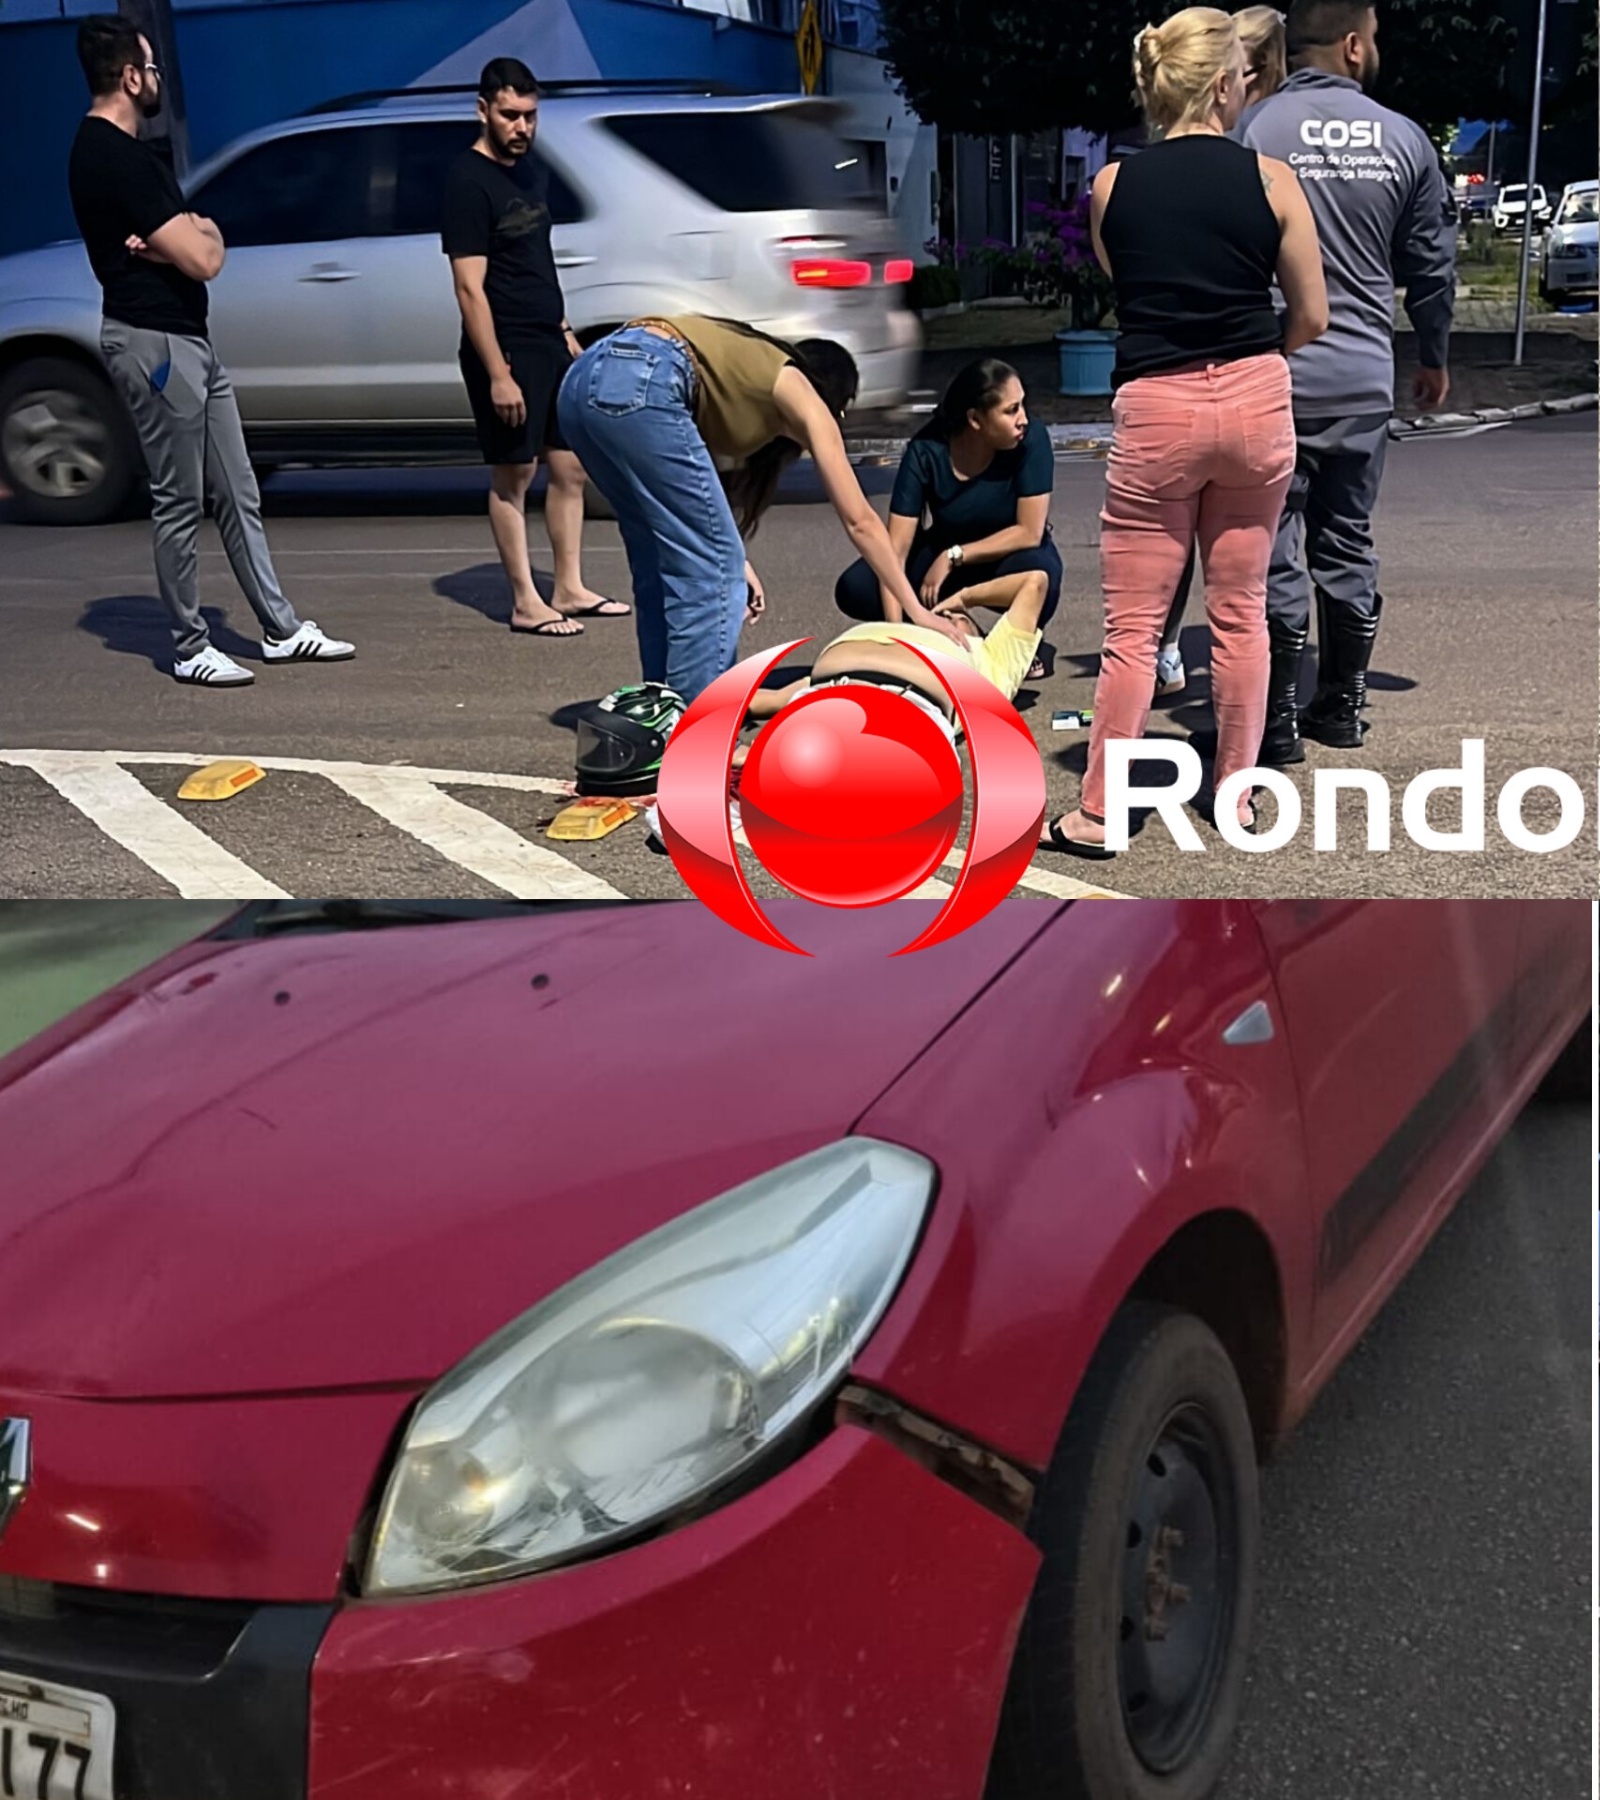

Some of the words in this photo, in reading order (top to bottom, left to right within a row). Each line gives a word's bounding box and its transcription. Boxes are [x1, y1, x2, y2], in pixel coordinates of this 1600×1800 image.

[1300, 119, 1382, 148] COSI
[1288, 152, 1325, 165] Centro
[1299, 166, 1355, 181] Segurança
